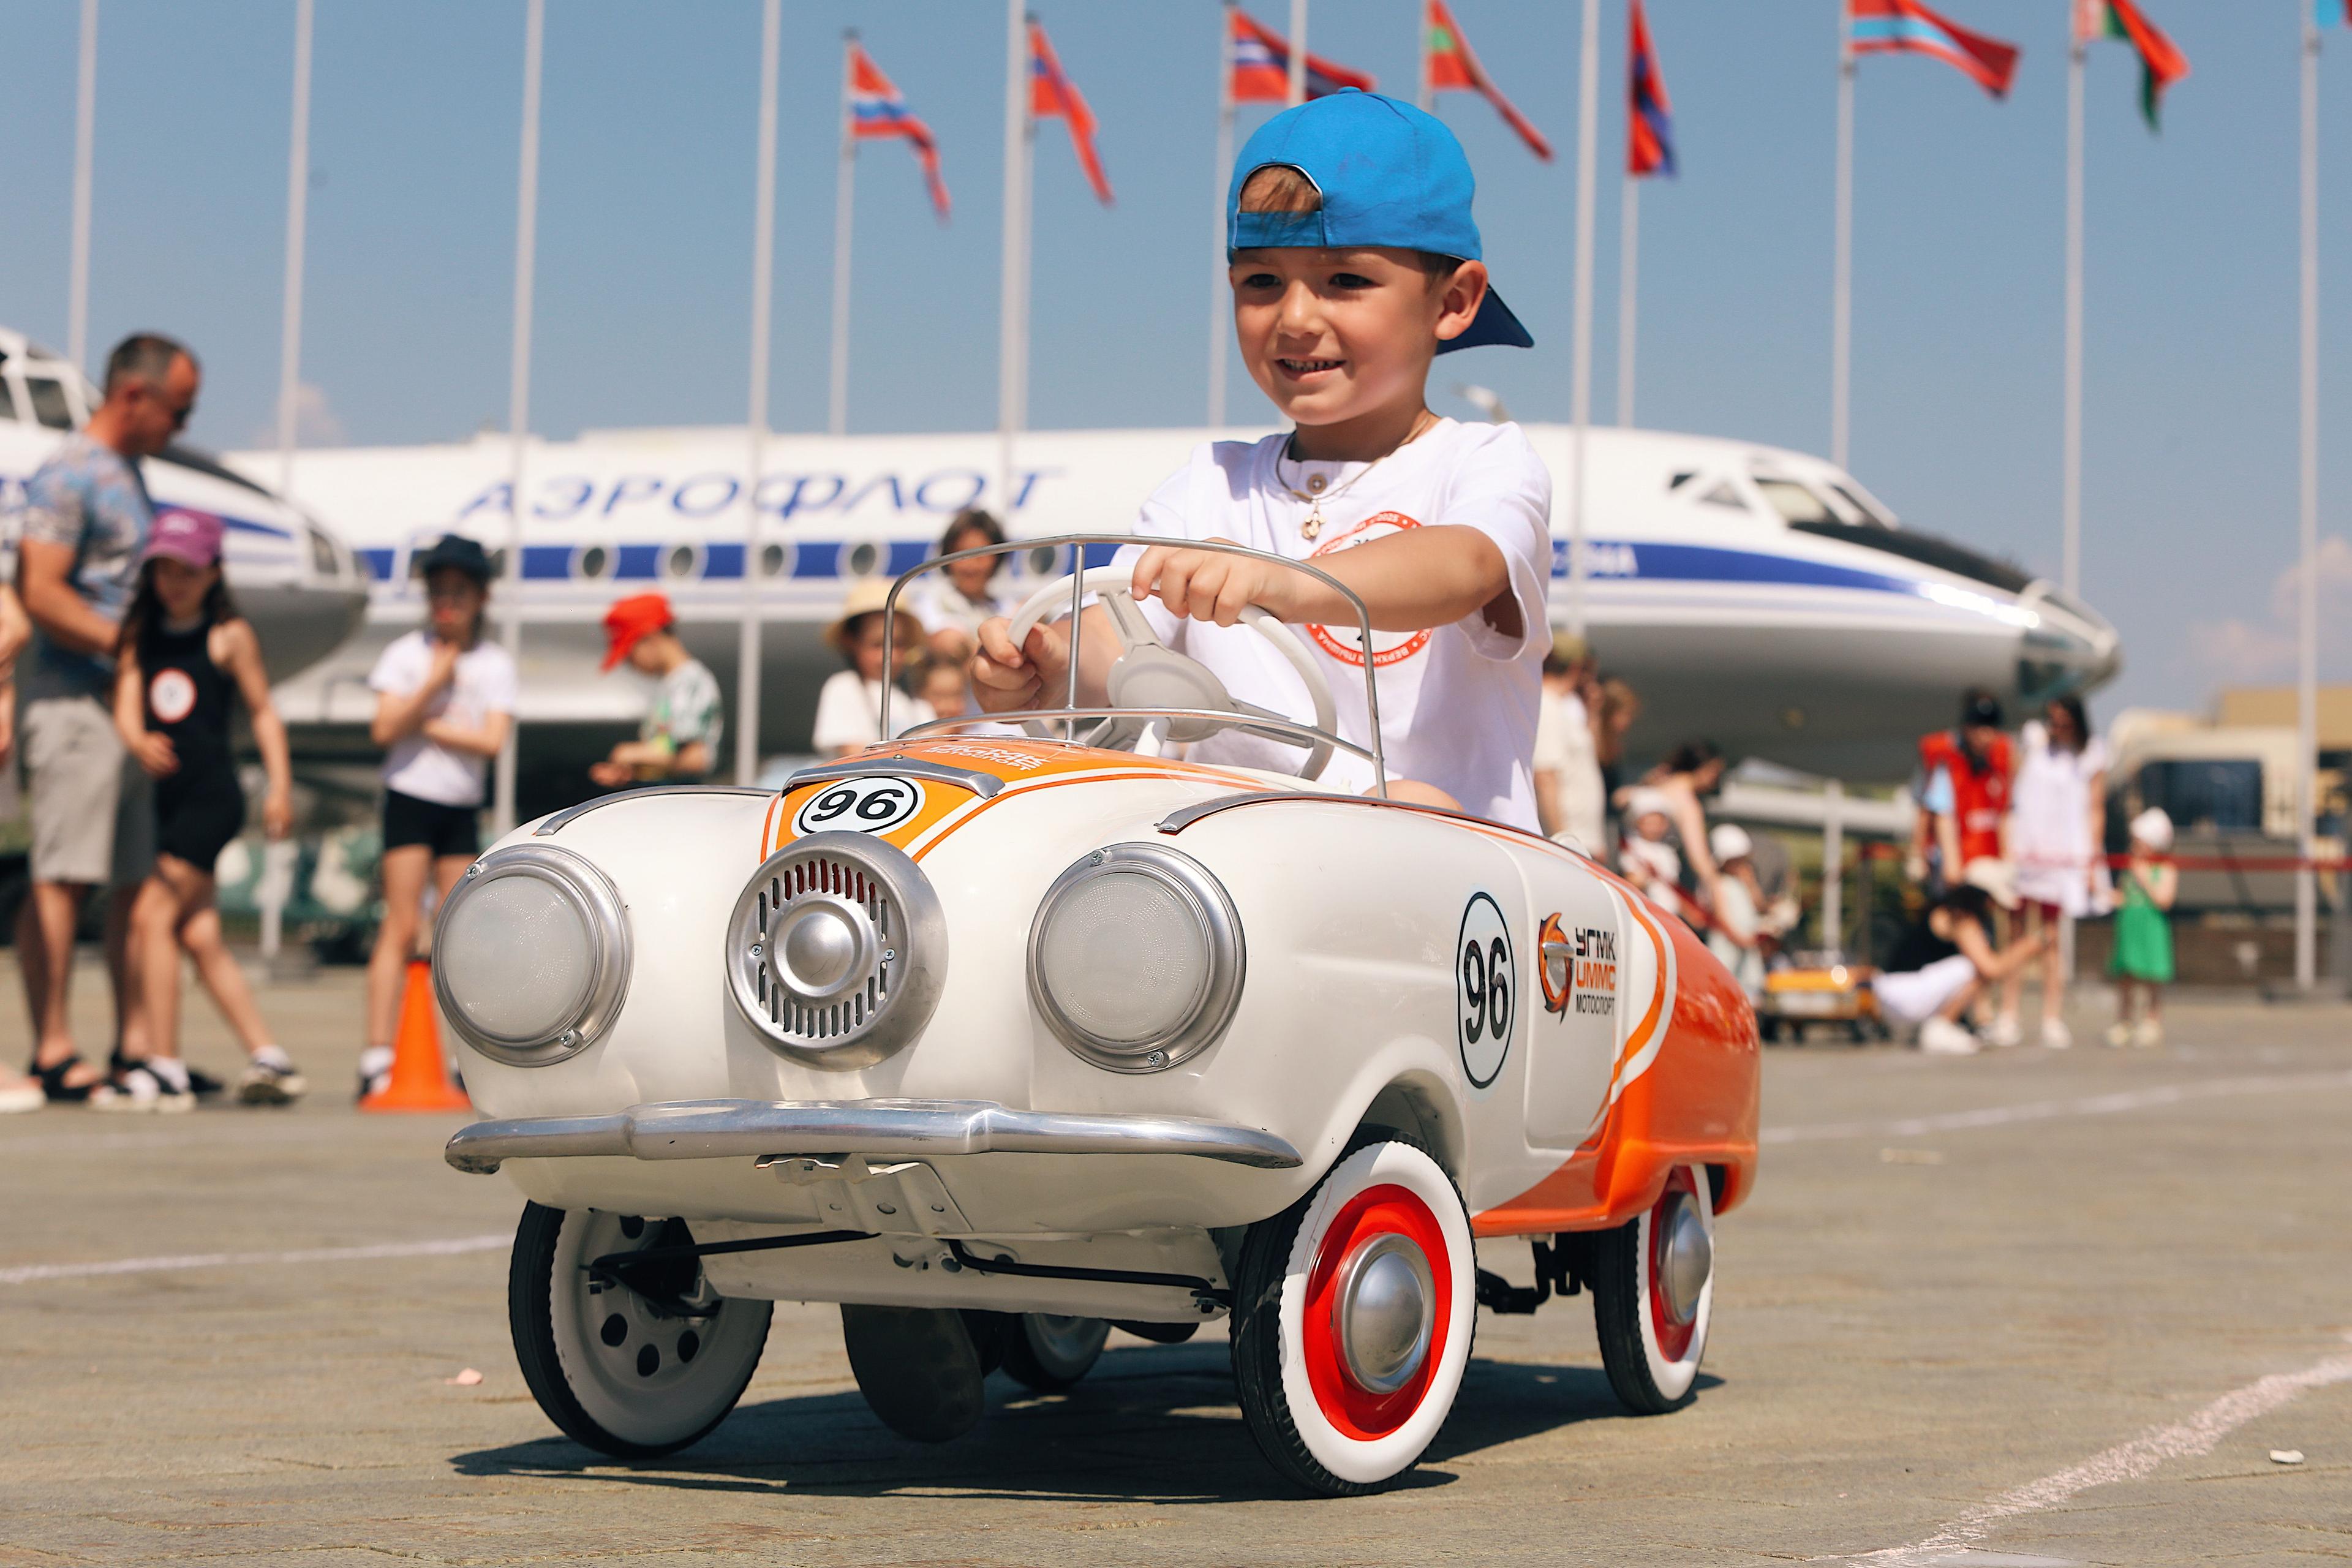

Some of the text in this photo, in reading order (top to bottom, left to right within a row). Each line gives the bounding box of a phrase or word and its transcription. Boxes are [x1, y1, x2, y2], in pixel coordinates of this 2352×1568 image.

[458, 466, 1068, 522] АЭРОФЛОТ
[1357, 646, 1409, 664] ВЕРХНЯ
[921, 749, 1031, 771] МОТОСПОРТ
[811, 788, 905, 821] 96
[1575, 927, 1616, 960] УГМК
[1463, 937, 1509, 1044] 96
[1575, 960, 1616, 992] UMMC
[1576, 993, 1615, 1016] МОТОСПОРТ
